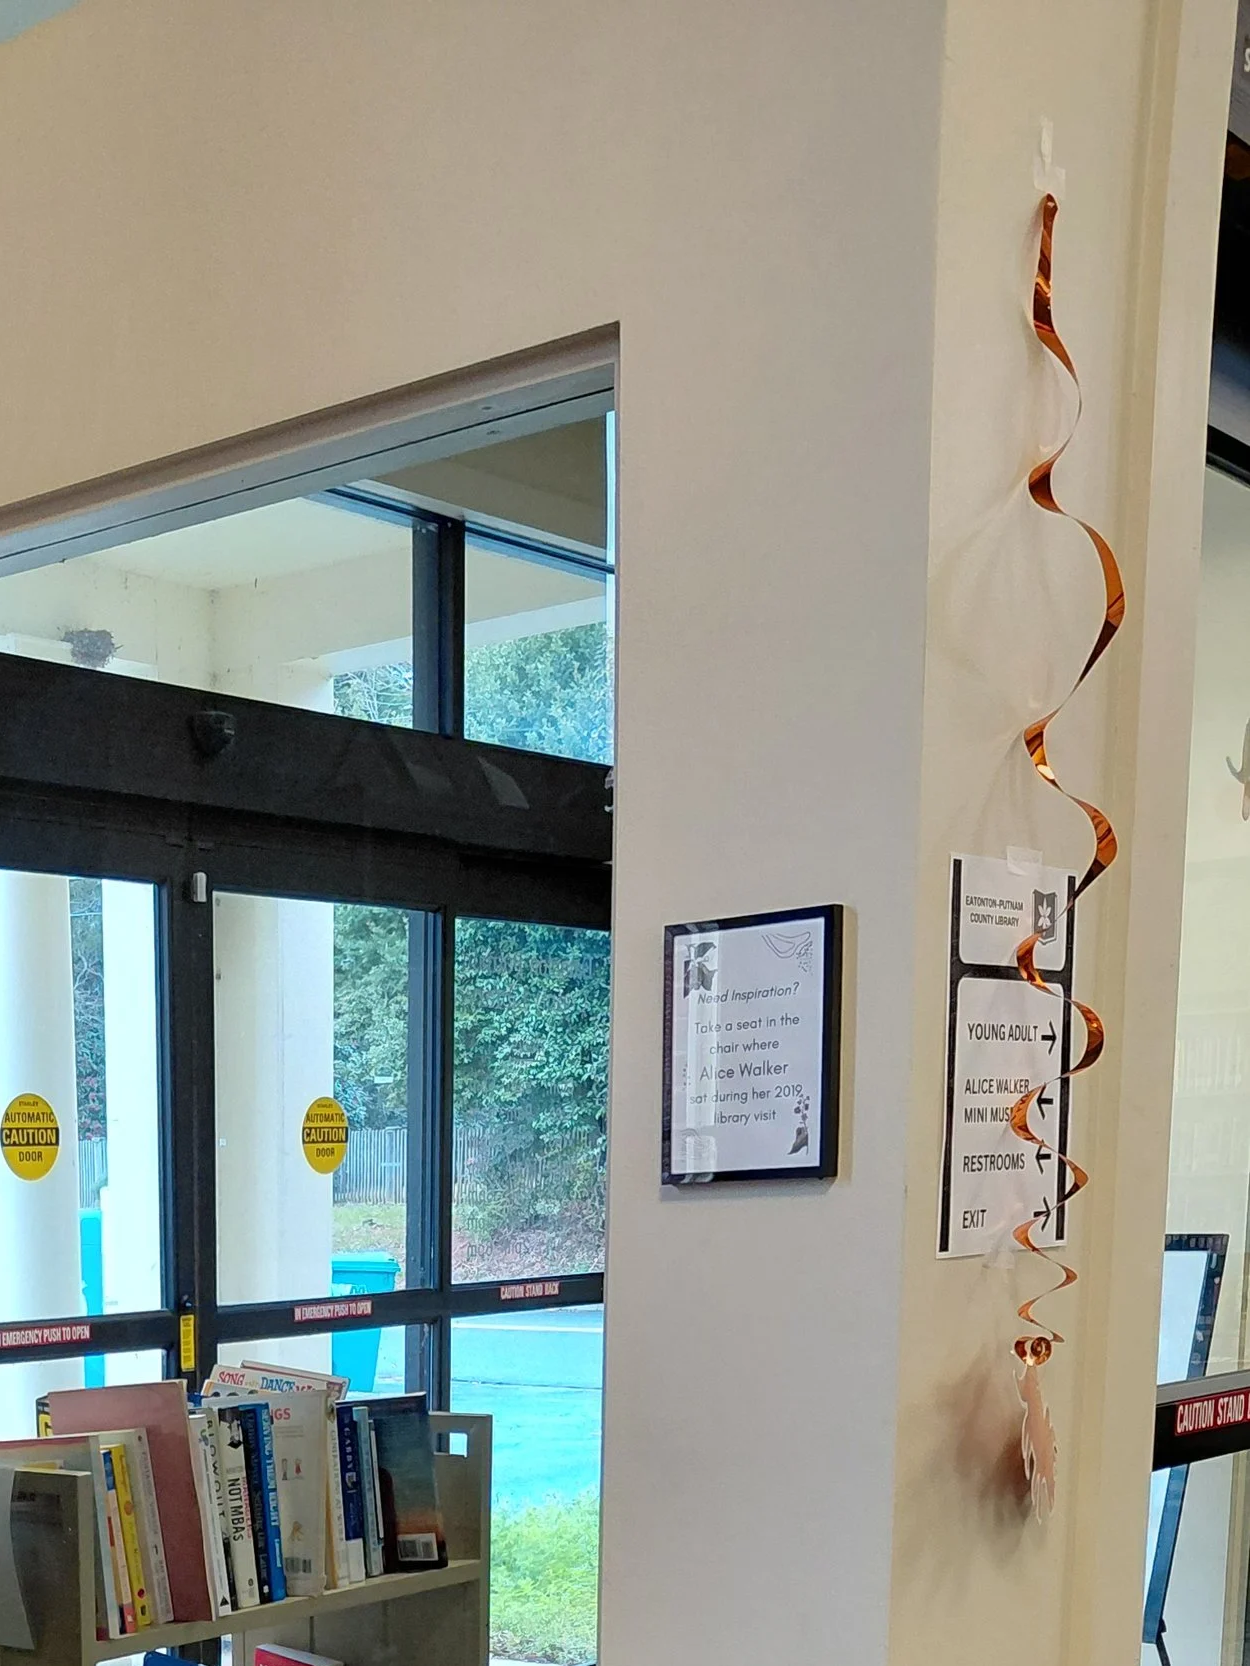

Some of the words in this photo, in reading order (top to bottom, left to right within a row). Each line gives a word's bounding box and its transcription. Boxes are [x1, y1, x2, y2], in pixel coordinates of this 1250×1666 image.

[965, 895, 1023, 911] EATONTON-PUTNAM
[970, 913, 994, 925] COUNTY
[995, 915, 1019, 927] LIBRARY
[697, 989, 728, 1005] Need
[731, 982, 800, 1003] Inspiration?
[694, 1021, 721, 1034] Take
[725, 1022, 733, 1031] a
[736, 1018, 762, 1031] seat
[766, 1016, 776, 1027] in
[780, 1013, 800, 1025] the
[967, 1023, 1005, 1041] YOUNG
[1007, 1025, 1038, 1042] ADULT
[710, 1041, 739, 1055] chair
[742, 1038, 779, 1051] where
[700, 1065, 735, 1081] Alice
[739, 1060, 789, 1077] Walker
[690, 1092, 707, 1104] sat
[712, 1090, 748, 1104] during
[752, 1087, 771, 1098] her
[775, 1084, 803, 1098] 2019
[965, 1079, 994, 1094] ALICE
[996, 1078, 1029, 1093] WALKER
[5, 1111, 55, 1123] AUTOMATIC
[306, 1112, 345, 1123] AUTOMATIC
[714, 1111, 751, 1126] library
[753, 1110, 776, 1121] visit
[964, 1107, 988, 1123] MINI
[990, 1107, 1010, 1122] MUS
[2, 1128, 56, 1144] CAUTION
[304, 1128, 346, 1142] CAUTION
[18, 1151, 43, 1162] DOOR
[316, 1147, 335, 1158] DOOR
[963, 1152, 1025, 1173] RESTROOMS
[962, 1209, 987, 1229] EXIT
[294, 1307, 301, 1321] IN
[302, 1305, 334, 1320] EMERGENCY
[335, 1303, 349, 1317] PUSH
[350, 1302, 356, 1315] TO
[357, 1301, 372, 1315] OPEN
[2, 1328, 42, 1346] EMERGENCY
[43, 1327, 61, 1343] PUSH
[62, 1326, 71, 1341] TO
[72, 1325, 90, 1340] OPEN
[219, 1370, 246, 1386] SONG
[1176, 1399, 1215, 1433] CAUTION
[1217, 1393, 1245, 1425] STAND
[227, 1477, 242, 1507] NOT
